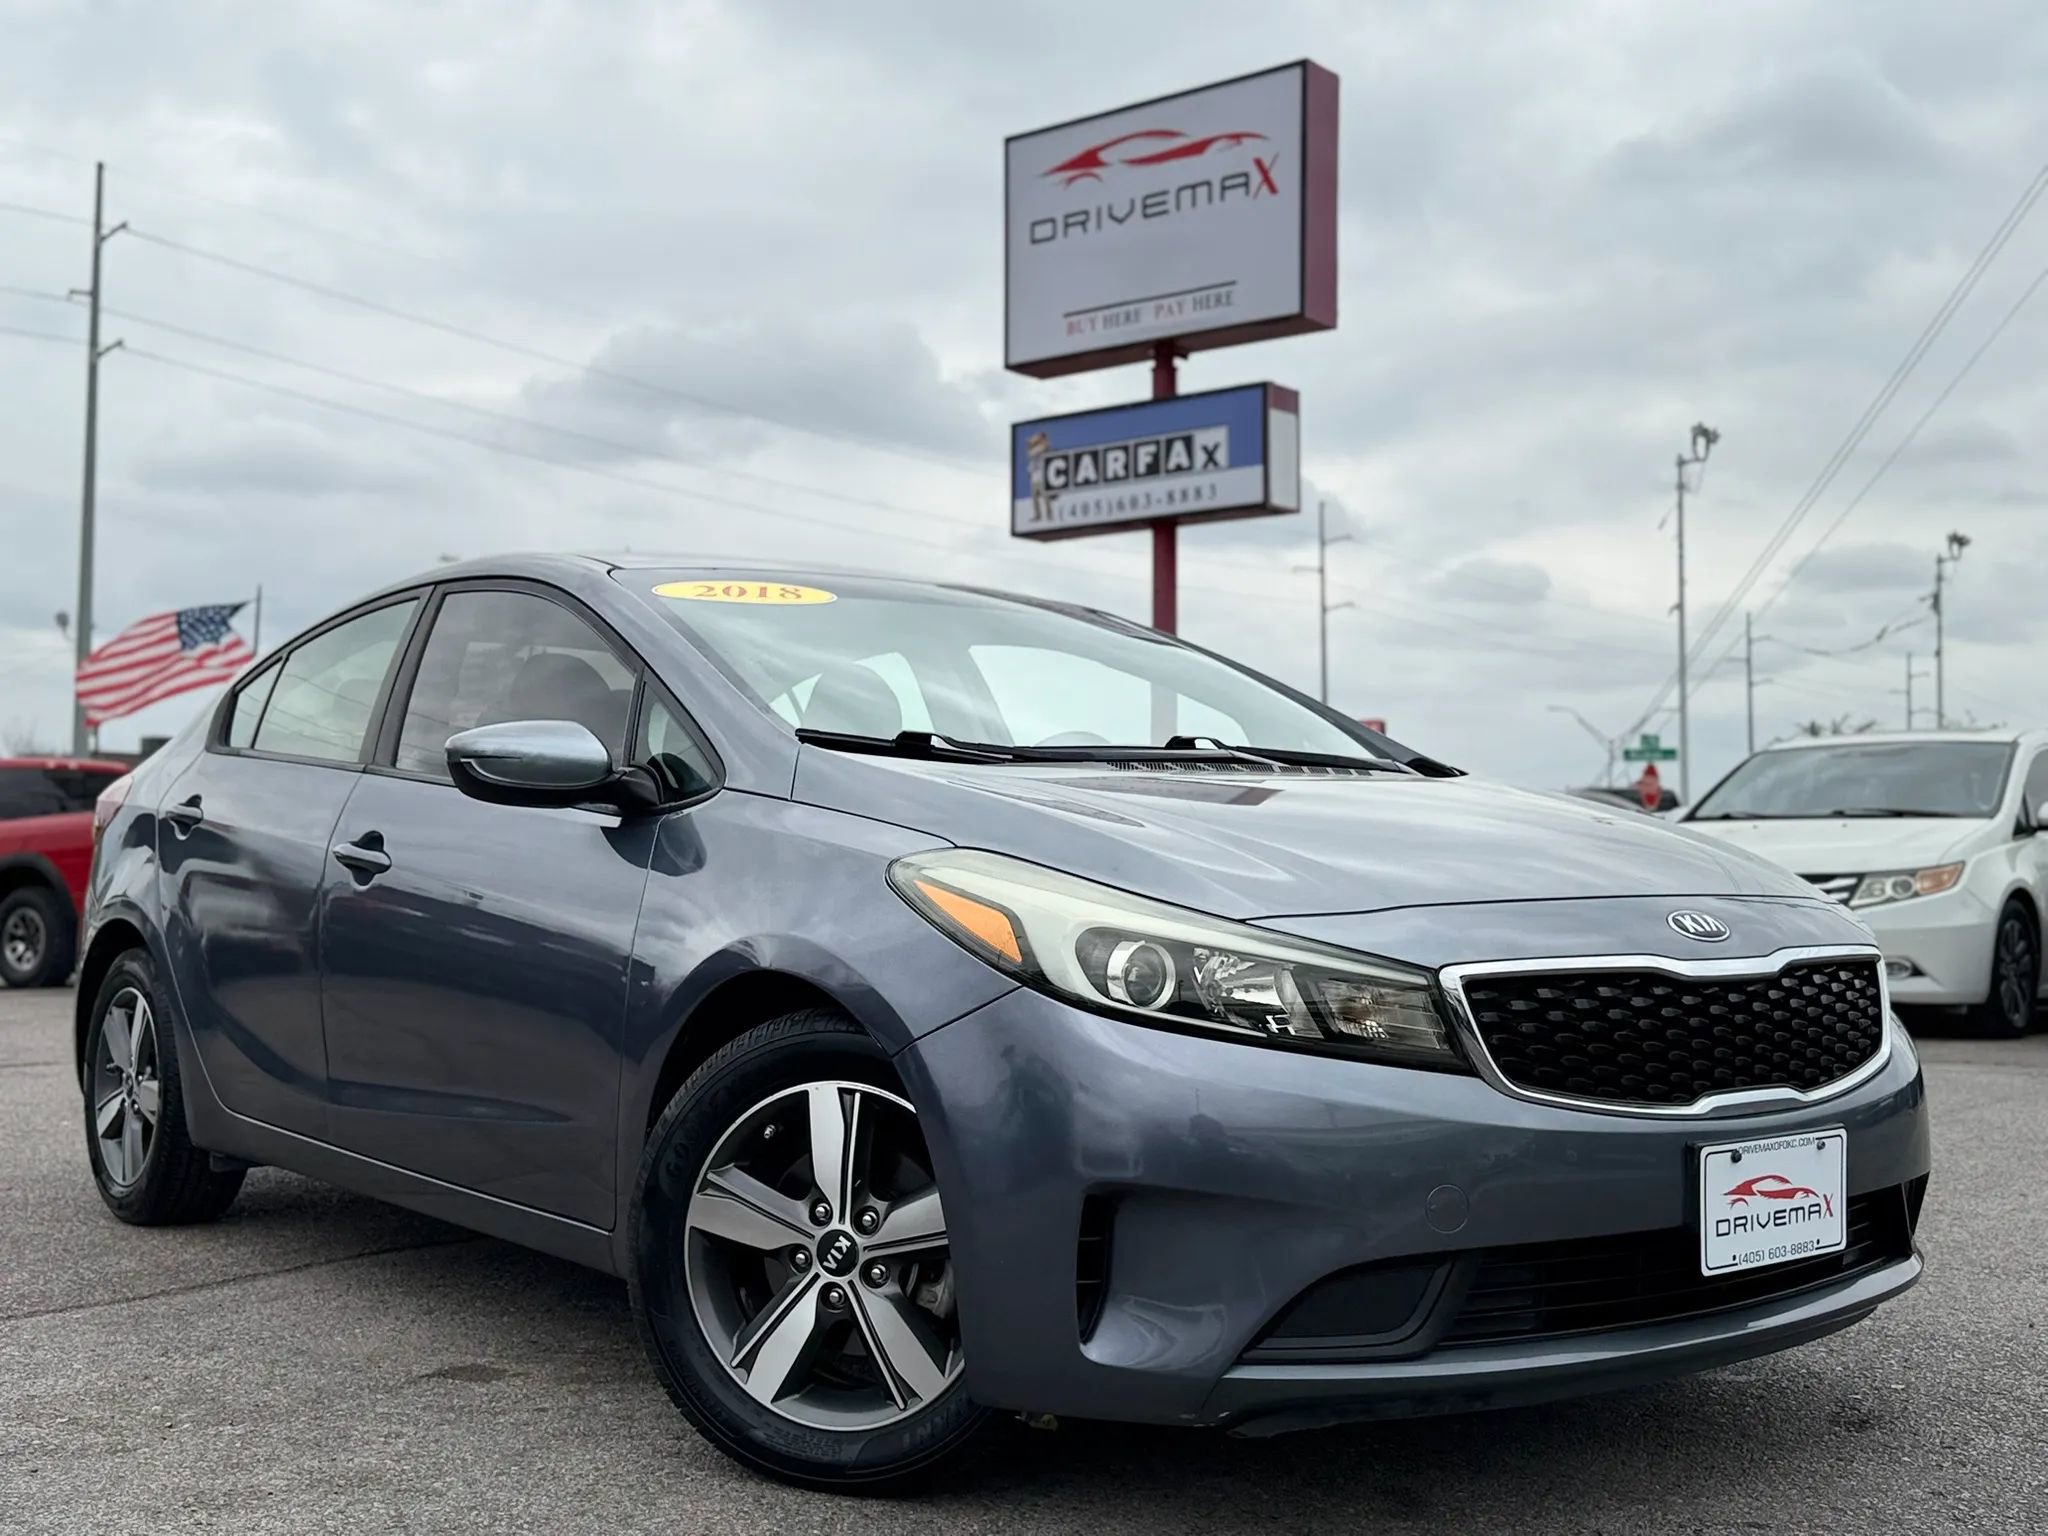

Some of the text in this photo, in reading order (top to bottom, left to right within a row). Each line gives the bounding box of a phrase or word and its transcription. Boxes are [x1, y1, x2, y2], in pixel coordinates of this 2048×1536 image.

[1029, 152, 1279, 246] DRIVEMAX
[1065, 290, 1235, 337] BUY HERE PAY HERE
[1045, 437, 1222, 490] CARFAX
[694, 585, 802, 599] 2018
[1674, 914, 1726, 933] KIA
[1716, 1193, 1834, 1238] DRIVEMAX
[822, 1235, 851, 1269] KIA
[1738, 1240, 1815, 1266] (405) 603-8883
